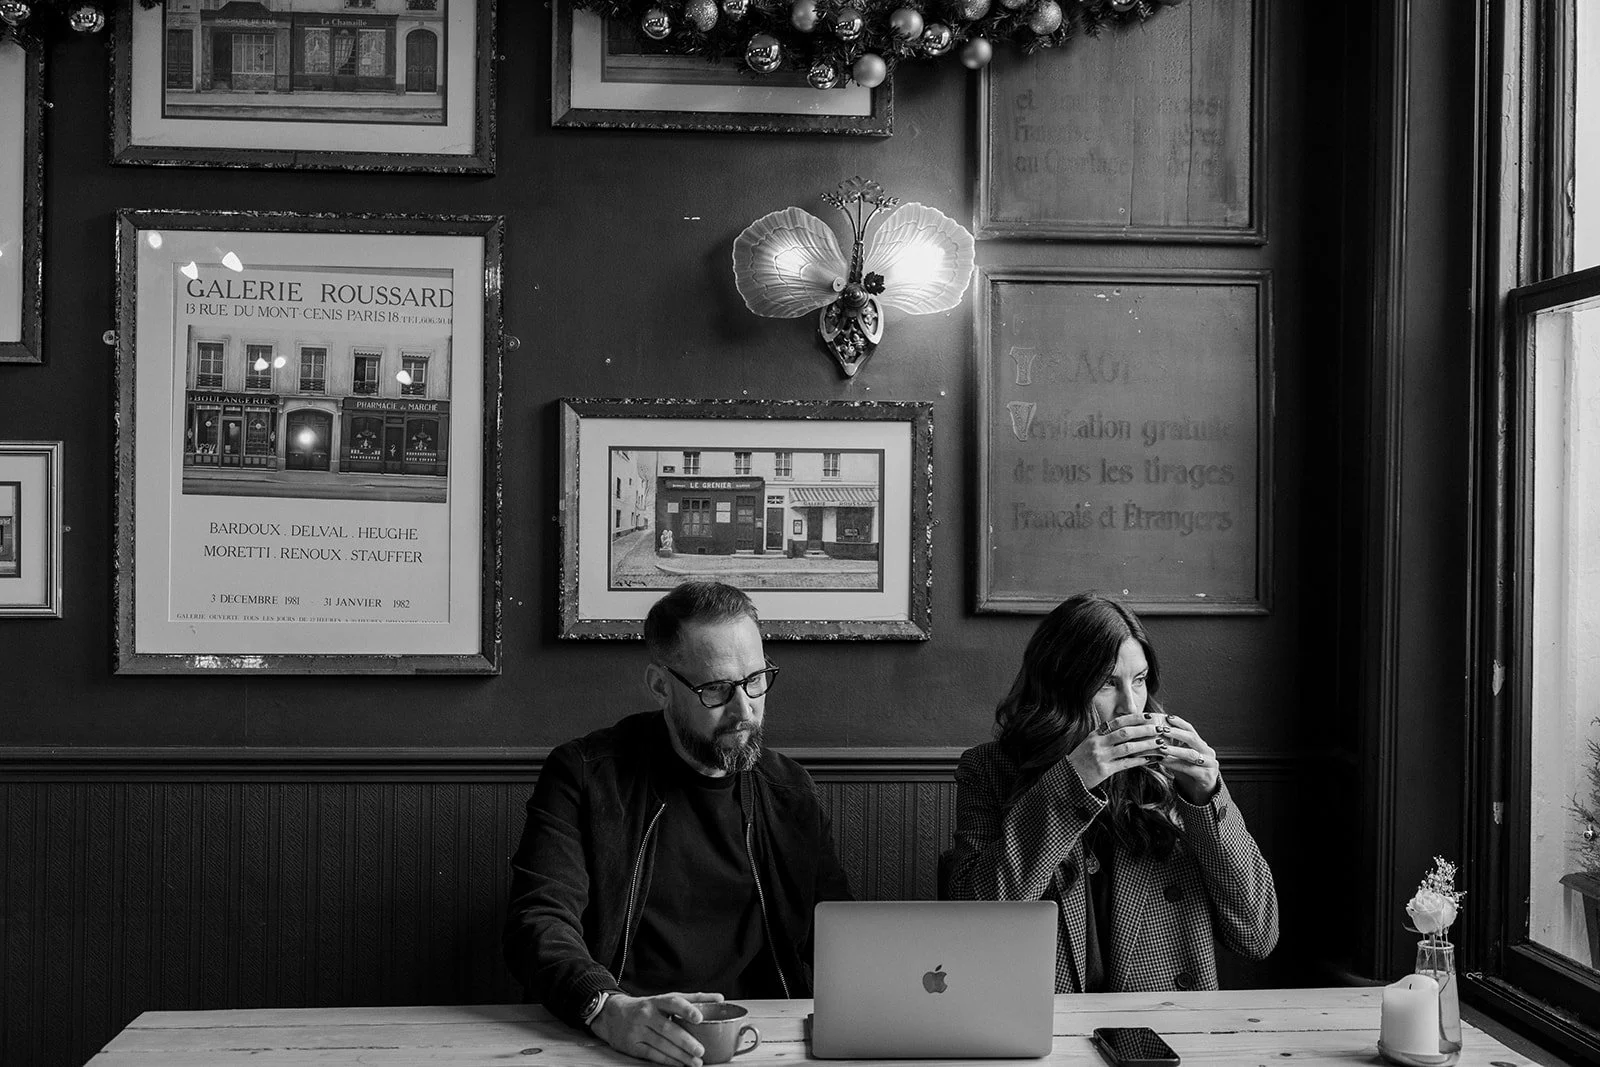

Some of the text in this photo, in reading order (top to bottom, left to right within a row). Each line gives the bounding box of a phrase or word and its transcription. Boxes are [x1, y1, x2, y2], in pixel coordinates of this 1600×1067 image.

[186, 278, 453, 308] GALERIE ROUSSARD
[186, 303, 196, 315] 13
[234, 304, 254, 317] DU
[347, 309, 386, 323] PARIS
[356, 401, 397, 410] PHARMACIE
[209, 522, 418, 541] BARDOUX DELVAL HEUGHE
[204, 545, 423, 564] MORETTI RENOUX STAUFFER
[211, 594, 410, 609] 3 DECEMBRE 1981 31 JANVIER 1982
